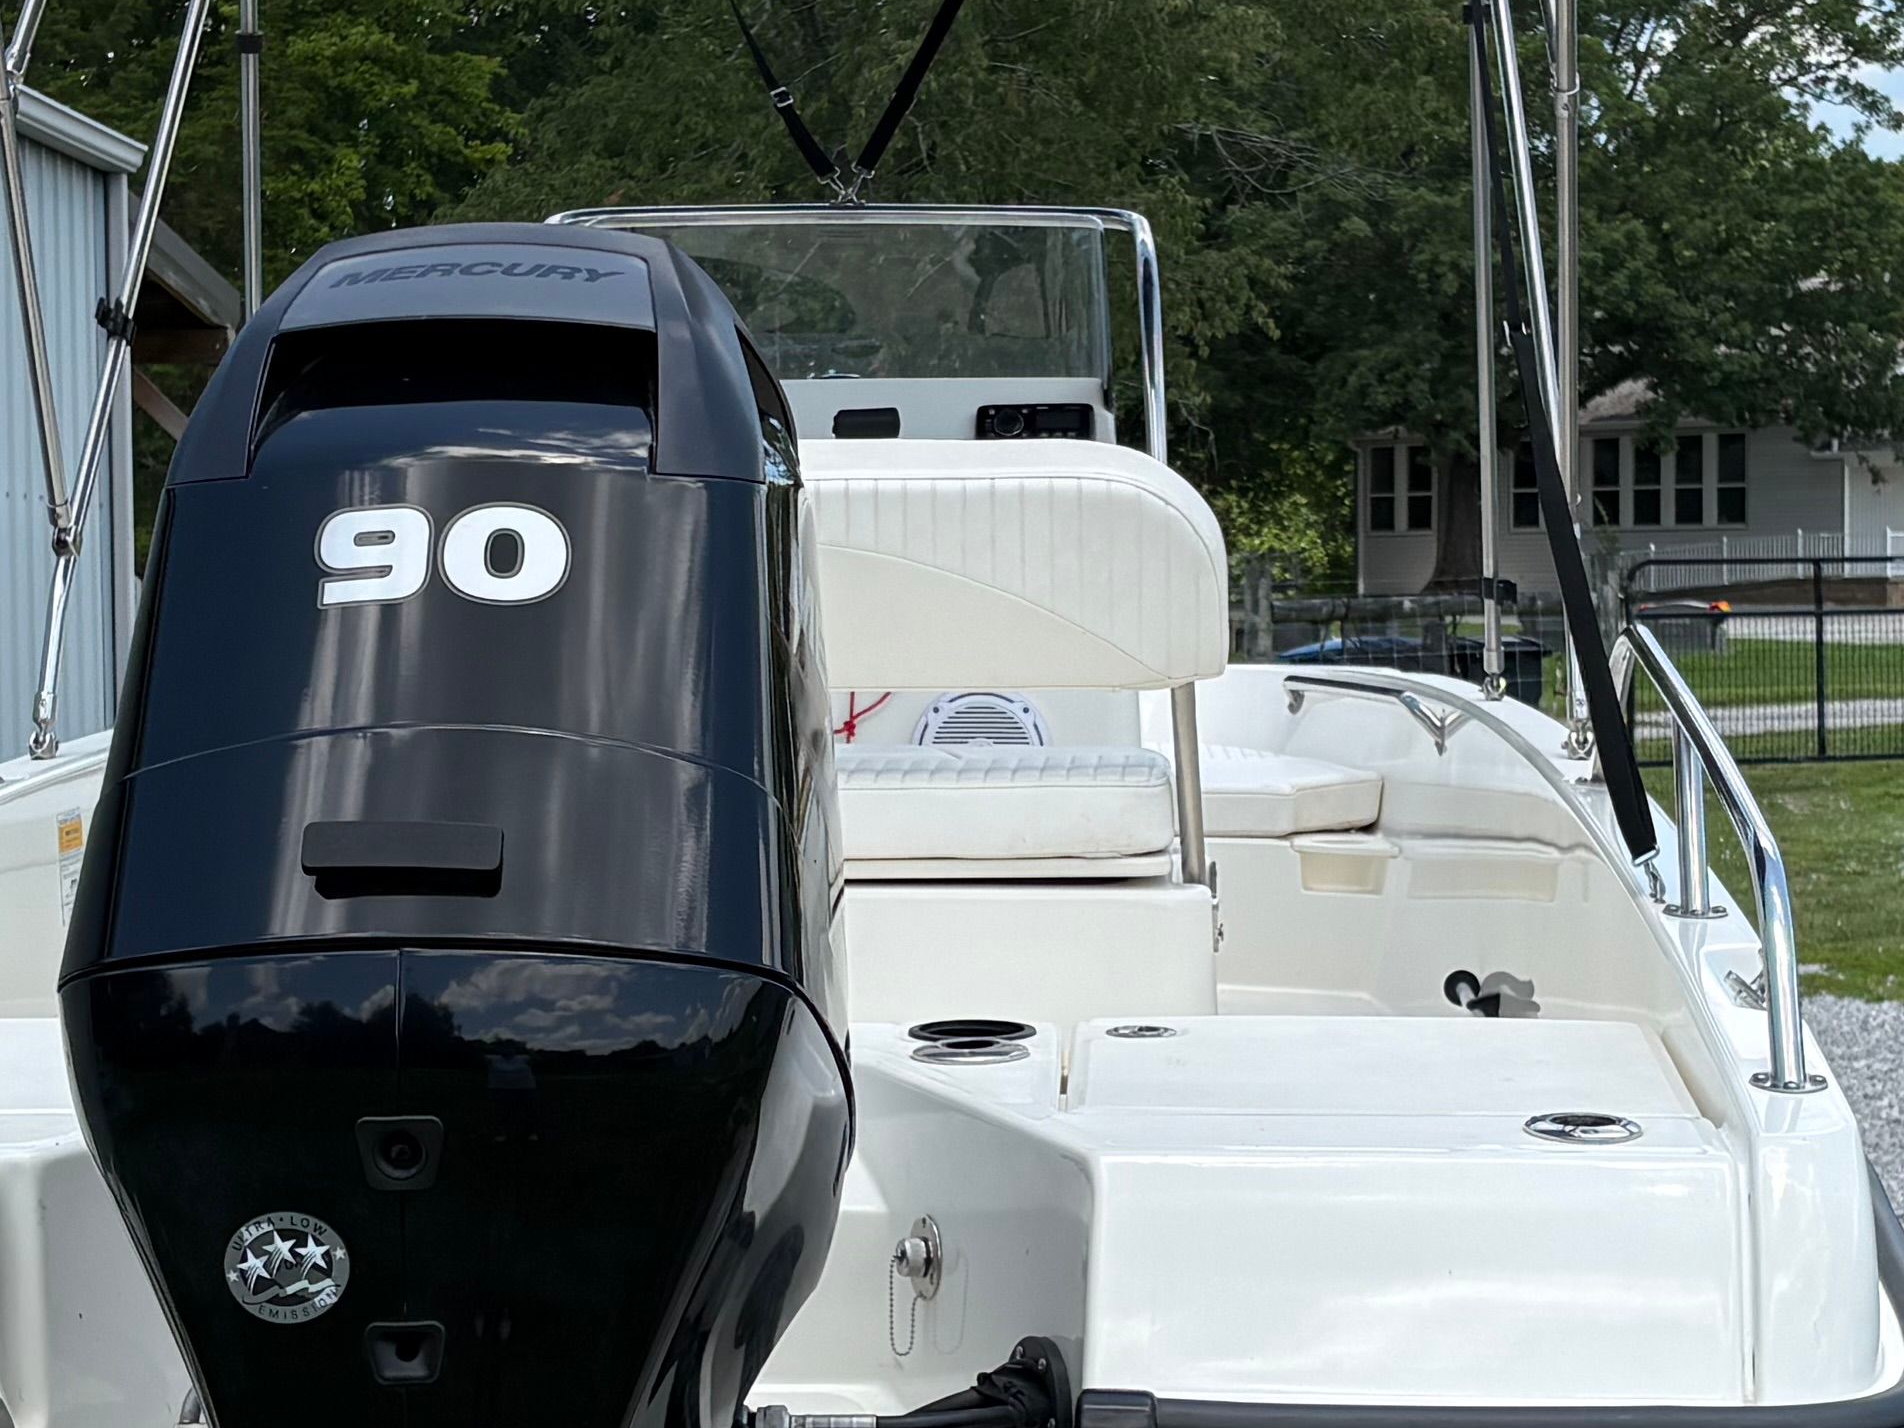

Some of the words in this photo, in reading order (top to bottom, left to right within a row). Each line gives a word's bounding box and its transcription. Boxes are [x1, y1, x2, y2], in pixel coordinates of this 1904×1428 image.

[329, 262, 625, 289] MERCURY
[317, 504, 570, 606] 90
[232, 1216, 275, 1252] ULTRA
[289, 1216, 328, 1237] LOW
